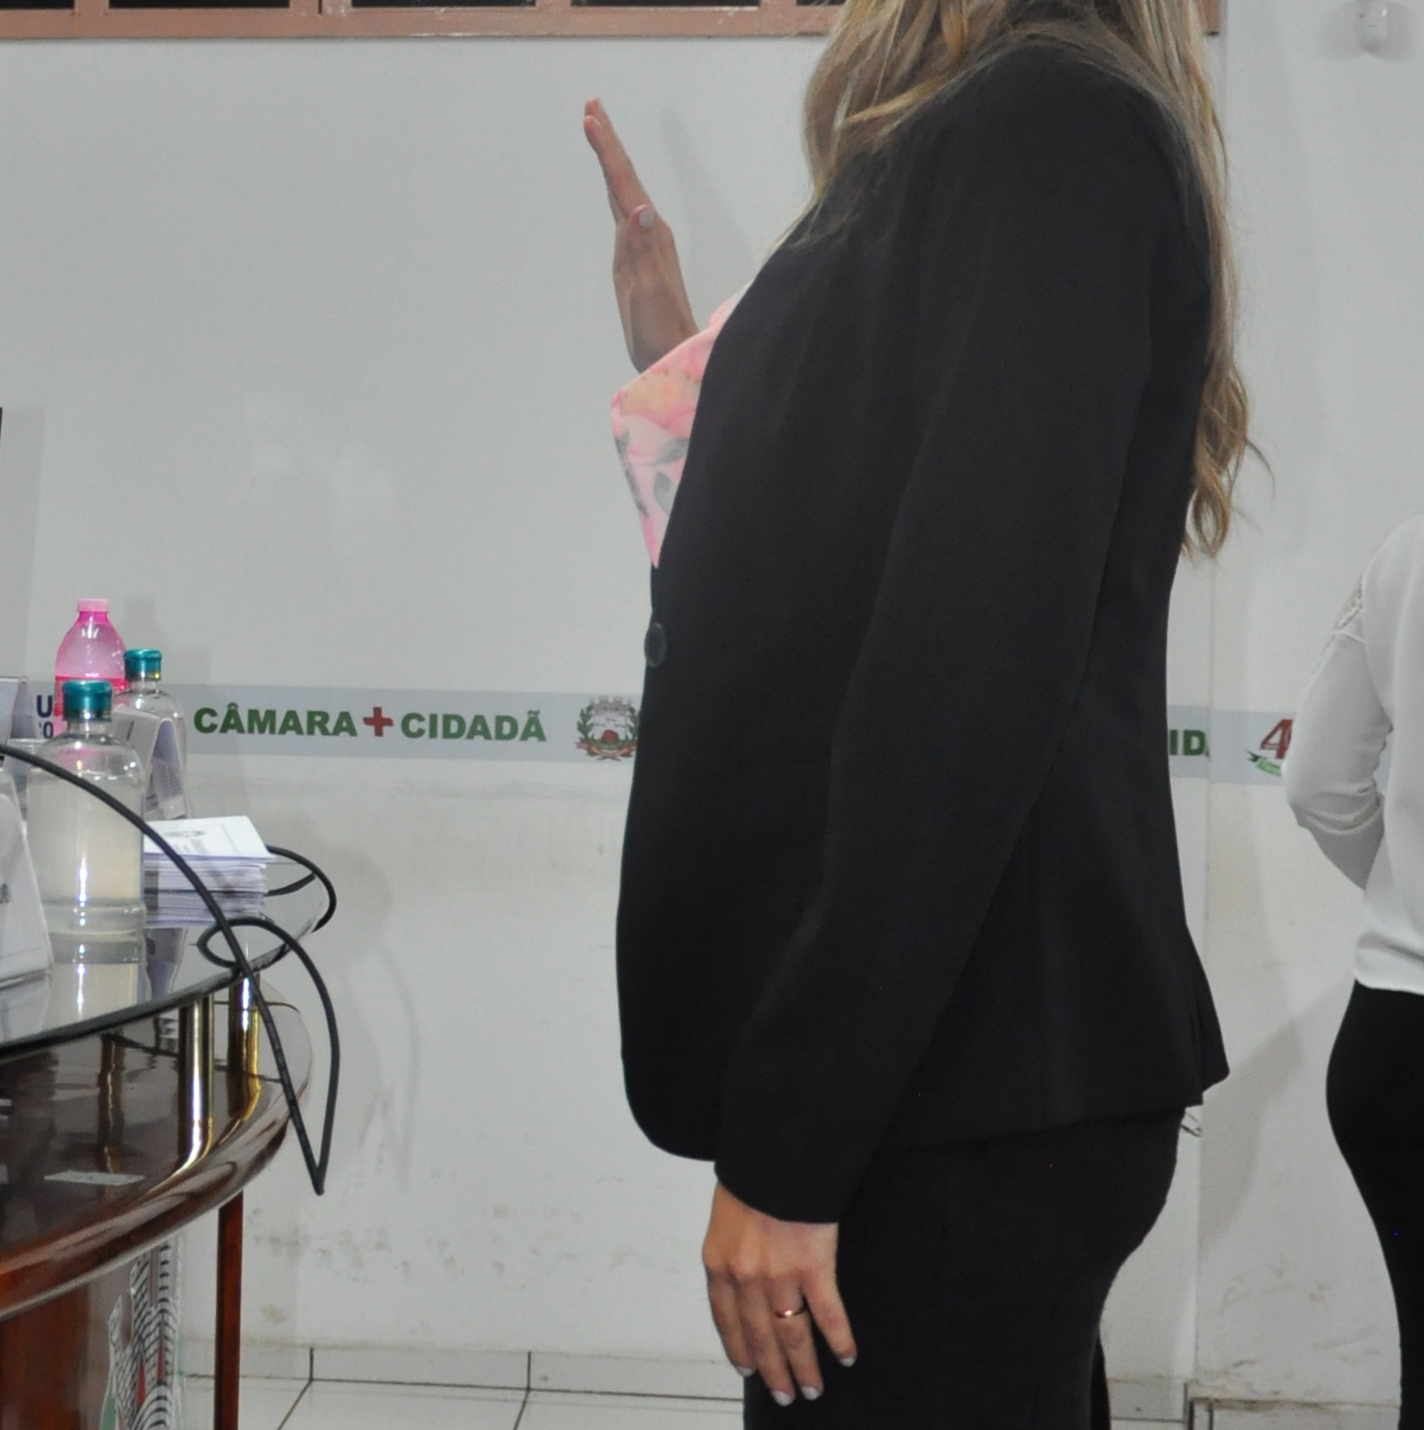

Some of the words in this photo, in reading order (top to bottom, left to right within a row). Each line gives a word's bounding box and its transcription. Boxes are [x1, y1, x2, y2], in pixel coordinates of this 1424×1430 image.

[194, 702, 358, 737] CÂMARA
[401, 710, 547, 742] CIDADÃ
[1260, 718, 1293, 760] 4
